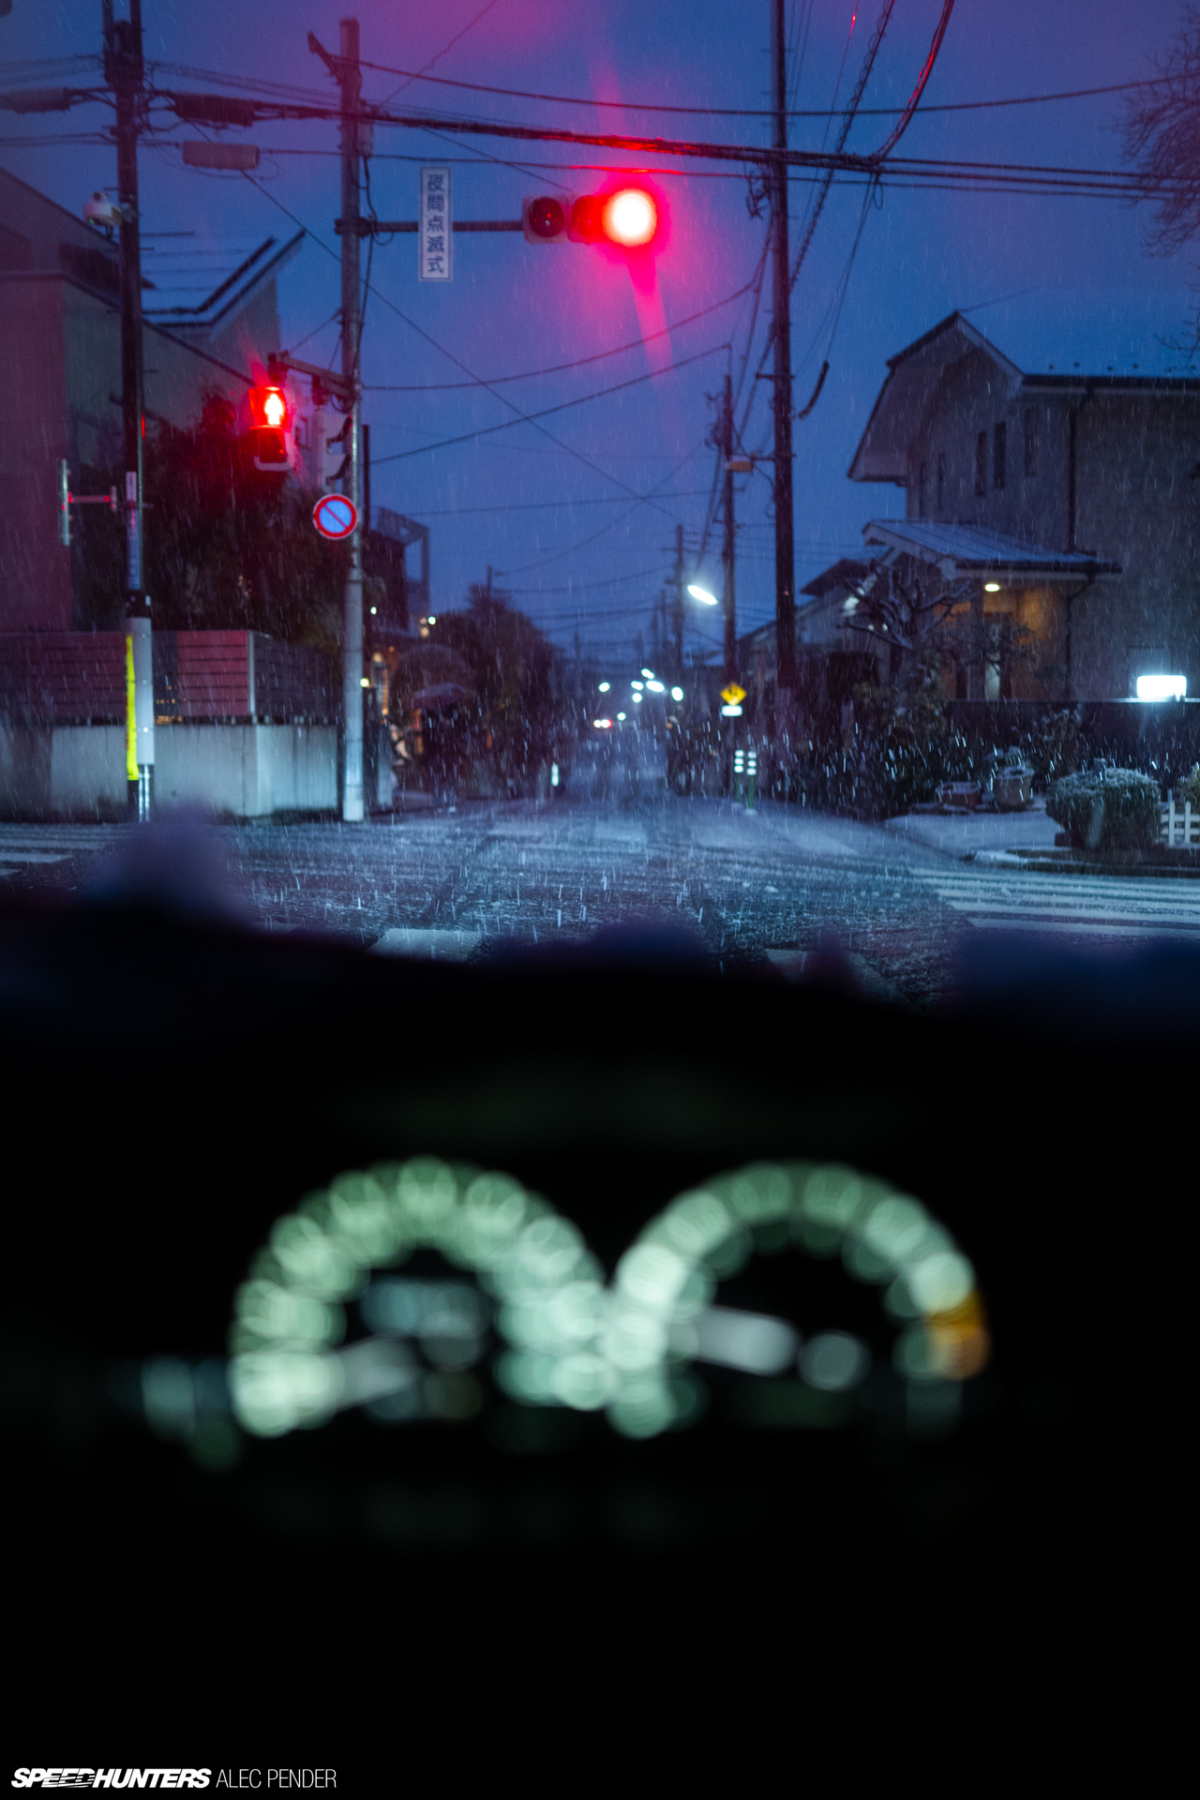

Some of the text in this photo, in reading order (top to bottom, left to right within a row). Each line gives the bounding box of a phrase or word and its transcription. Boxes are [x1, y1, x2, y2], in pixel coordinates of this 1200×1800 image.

[427, 174, 445, 274] 夜間点滅式
